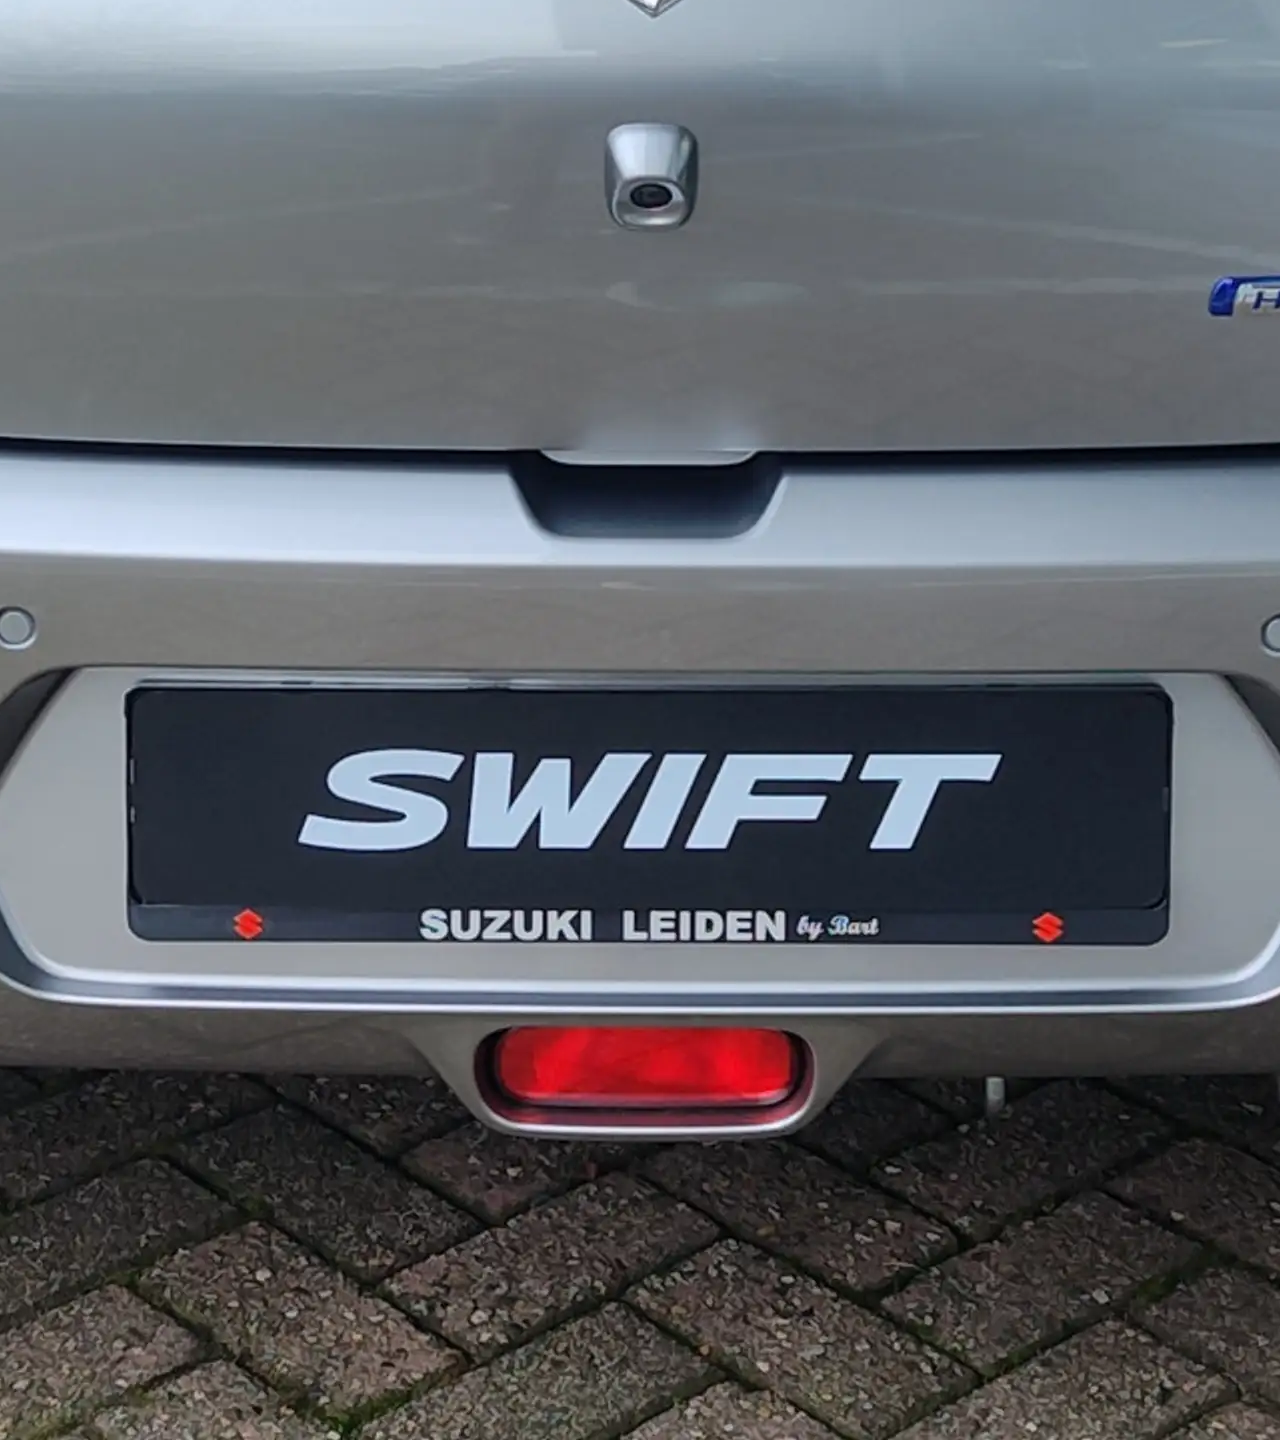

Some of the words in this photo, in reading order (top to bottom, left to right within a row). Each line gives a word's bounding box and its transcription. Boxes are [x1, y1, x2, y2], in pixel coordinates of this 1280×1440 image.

[298, 749, 1002, 851] SWIFT
[419, 909, 593, 941] SUZUKI
[622, 909, 786, 941] LEIDEN
[796, 915, 824, 940] by
[827, 915, 879, 936] Bart
